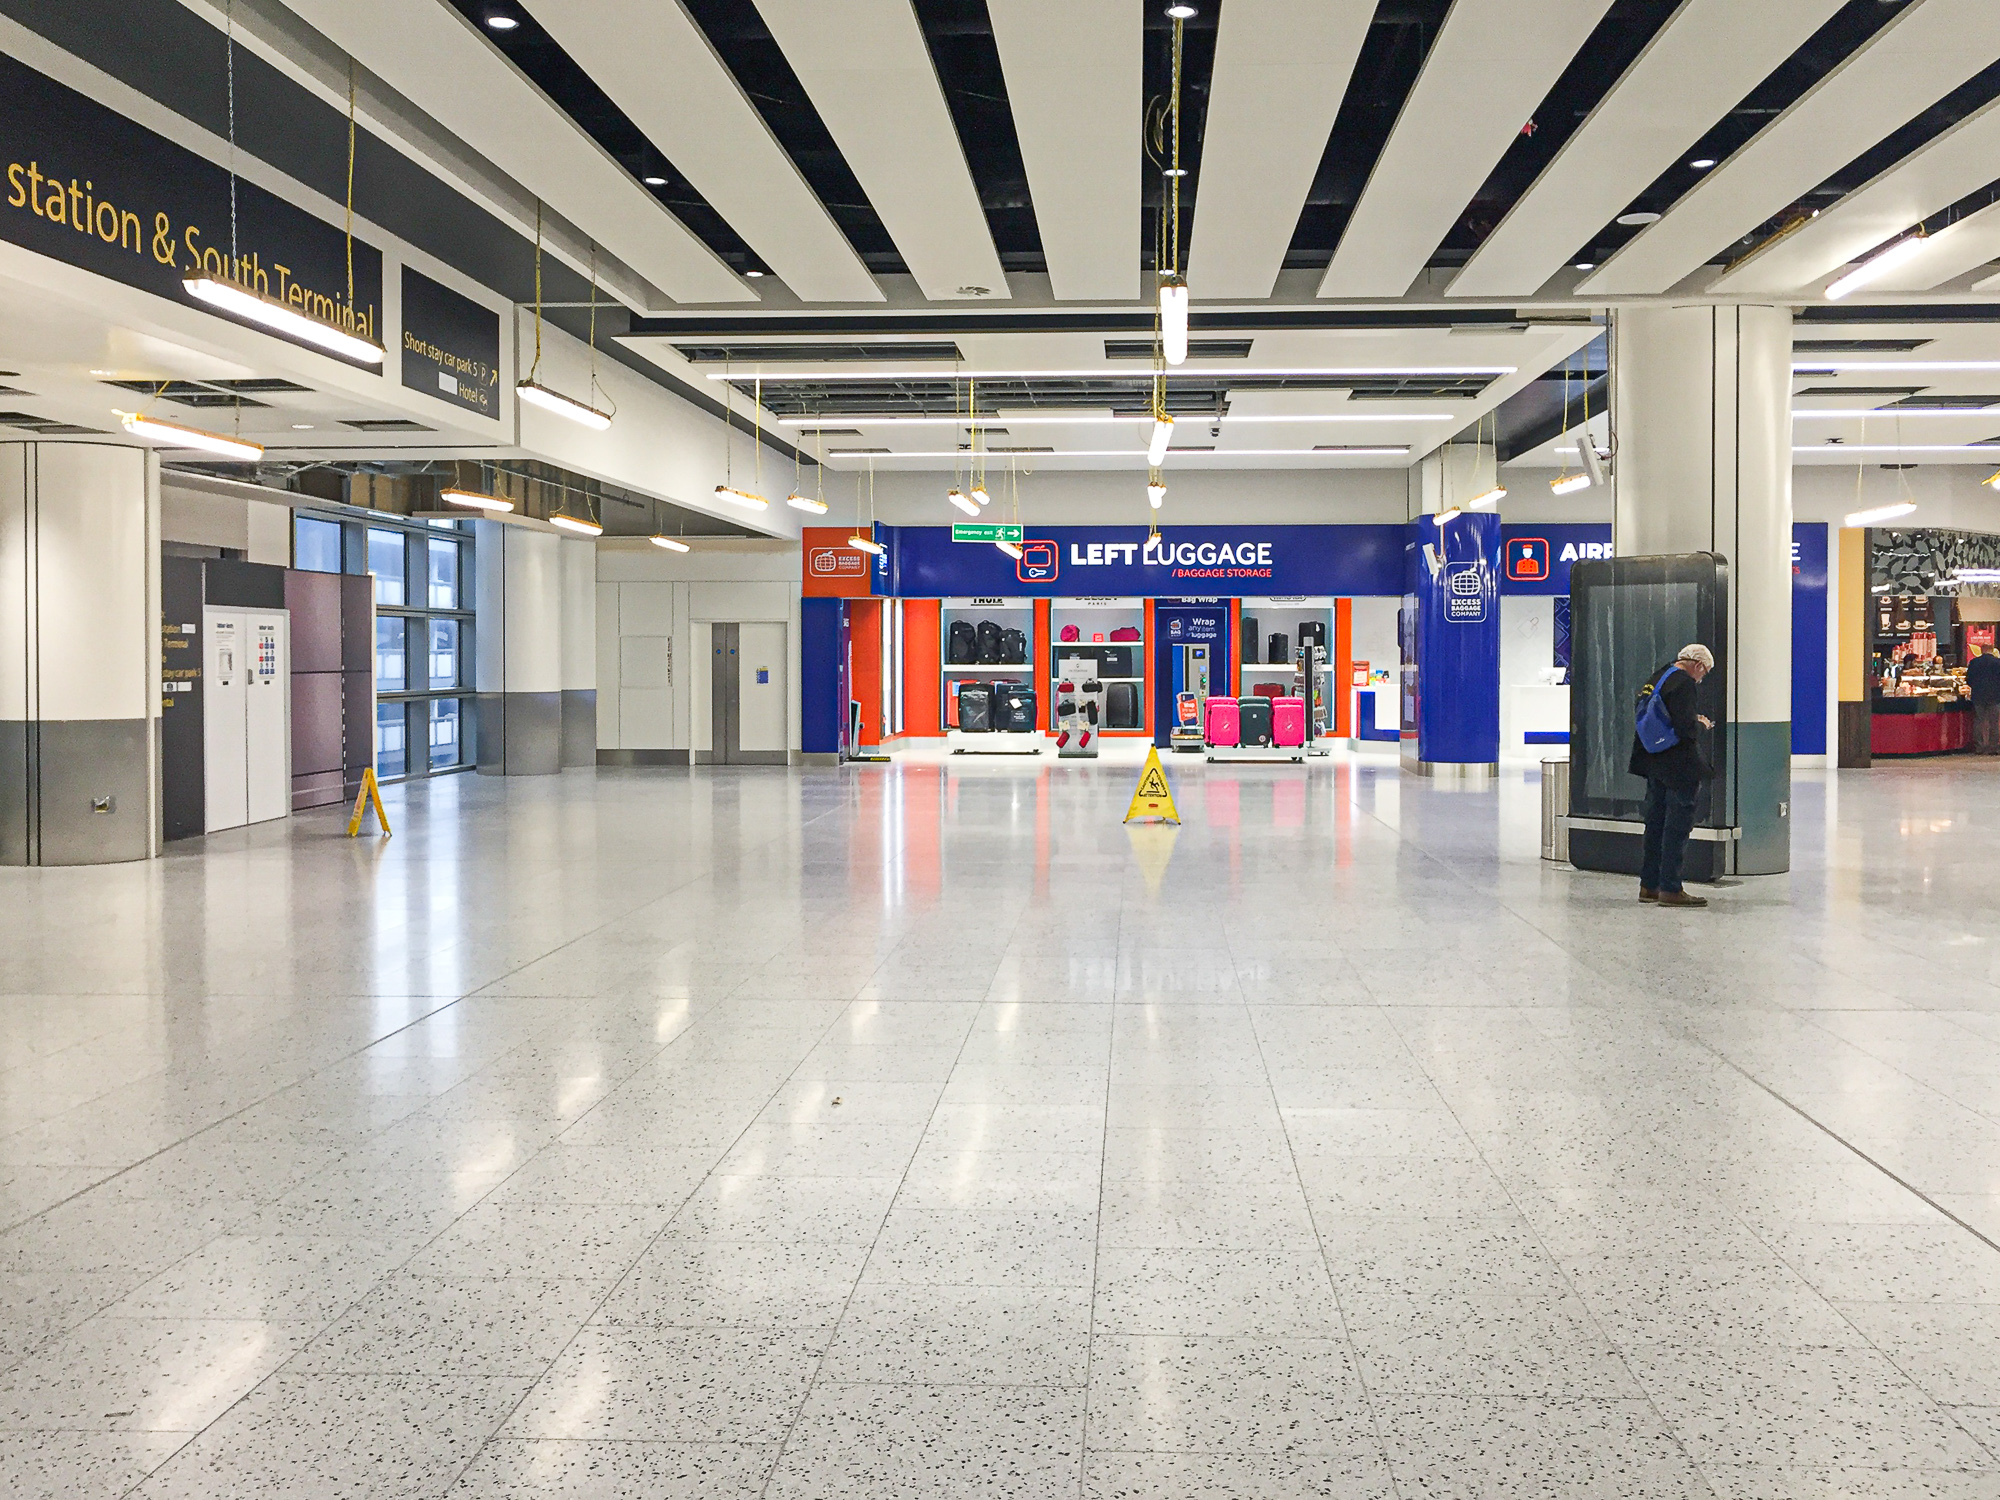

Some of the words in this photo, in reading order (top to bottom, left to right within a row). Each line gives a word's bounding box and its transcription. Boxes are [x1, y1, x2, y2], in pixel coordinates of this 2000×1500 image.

[8, 161, 142, 254] station
[152, 211, 177, 268] &
[185, 225, 269, 293] South
[274, 263, 374, 339] Terminal
[404, 331, 427, 355] Short
[428, 344, 444, 366] stay
[444, 352, 456, 367] car
[456, 357, 472, 375] park
[458, 381, 478, 403] Hotel
[1070, 543, 1138, 565] LEFT
[1143, 542, 1273, 566] LUGGAGE
[1227, 568, 1272, 578] STORAGE
[1192, 618, 1216, 626] Wrap
